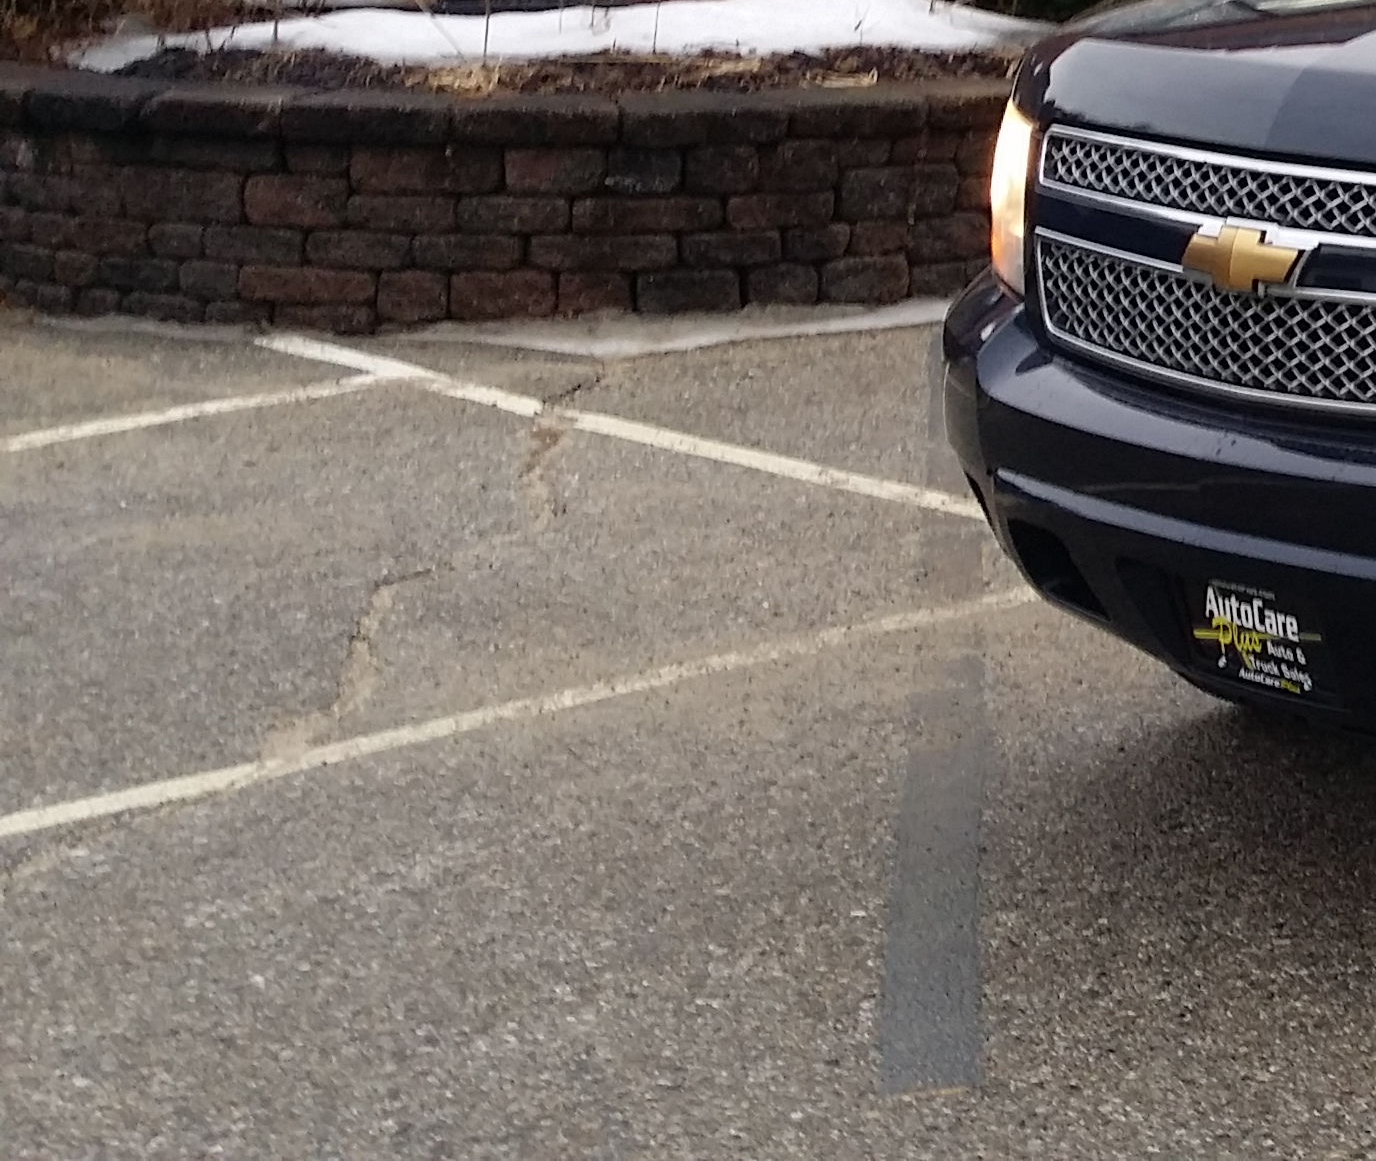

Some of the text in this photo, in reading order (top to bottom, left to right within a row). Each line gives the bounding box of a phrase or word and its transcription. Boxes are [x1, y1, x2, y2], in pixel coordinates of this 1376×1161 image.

[1205, 585, 1300, 643] AutoCare
[1212, 616, 1263, 655] Plus
[1267, 640, 1295, 662] Auto
[1249, 654, 1280, 677] Truck
